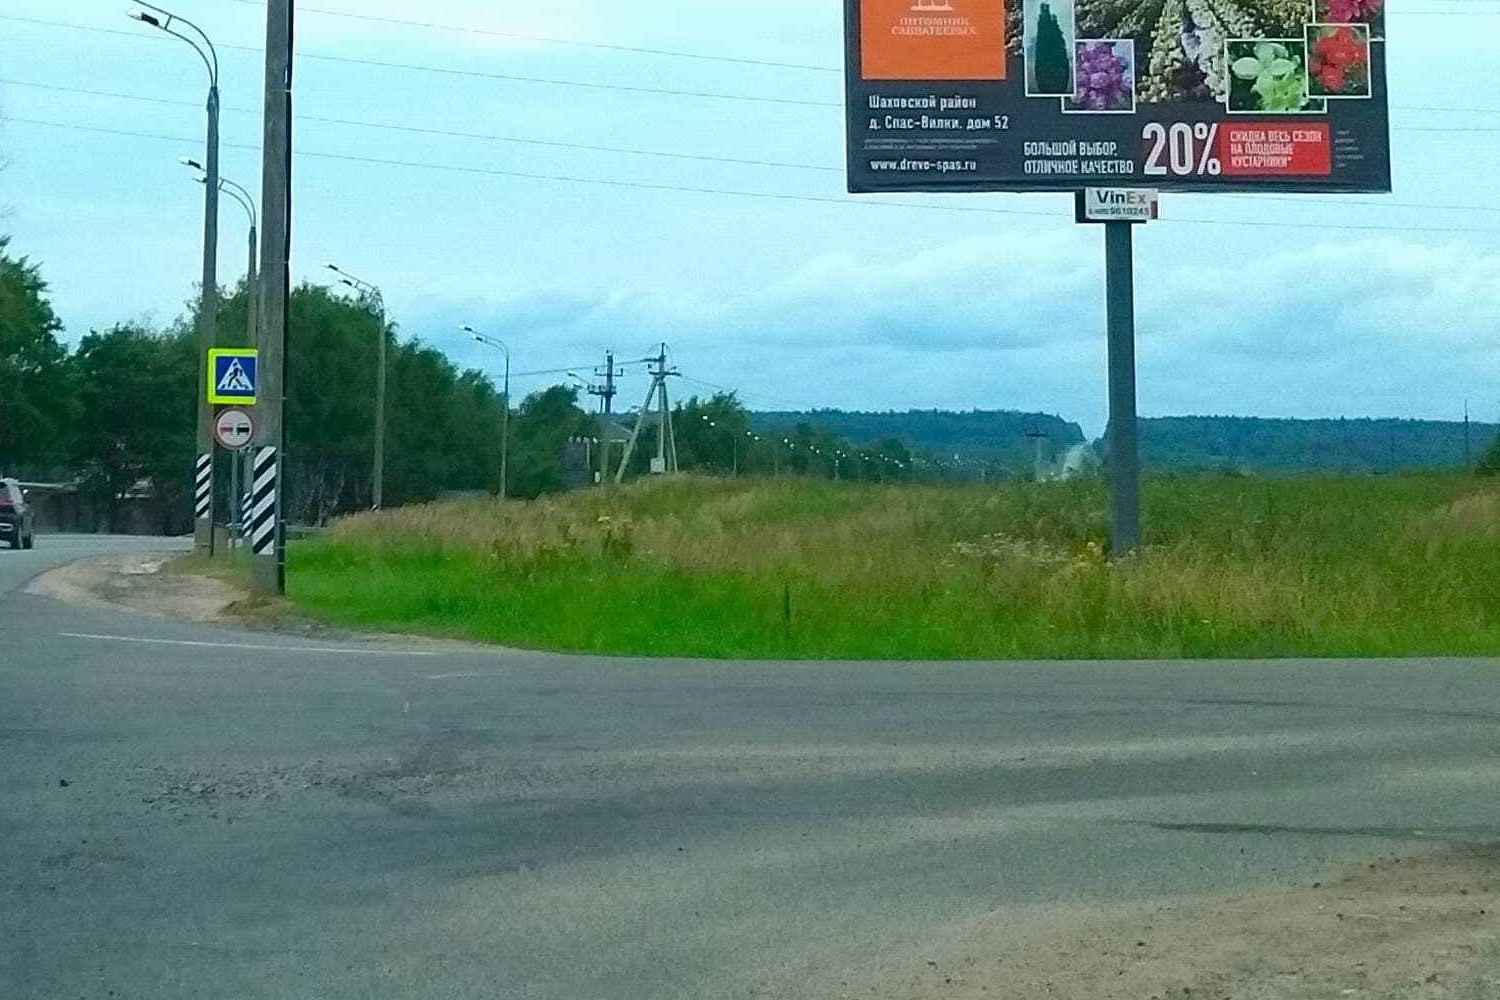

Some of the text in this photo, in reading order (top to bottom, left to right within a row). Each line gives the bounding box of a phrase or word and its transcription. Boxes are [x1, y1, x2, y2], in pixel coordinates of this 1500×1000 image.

[869, 95, 977, 111] Шаховской район
[966, 118, 991, 131] дом
[994, 115, 1009, 129] 52
[1024, 140, 1076, 156] БОЛЬШОЙ
[1142, 122, 1221, 176] 20%
[870, 158, 977, 173] www.drevo-spas.ru
[1024, 159, 1134, 174] ОТЛИЧНОЕ КАЧЕСТВО
[1096, 191, 1147, 204] VinEx
